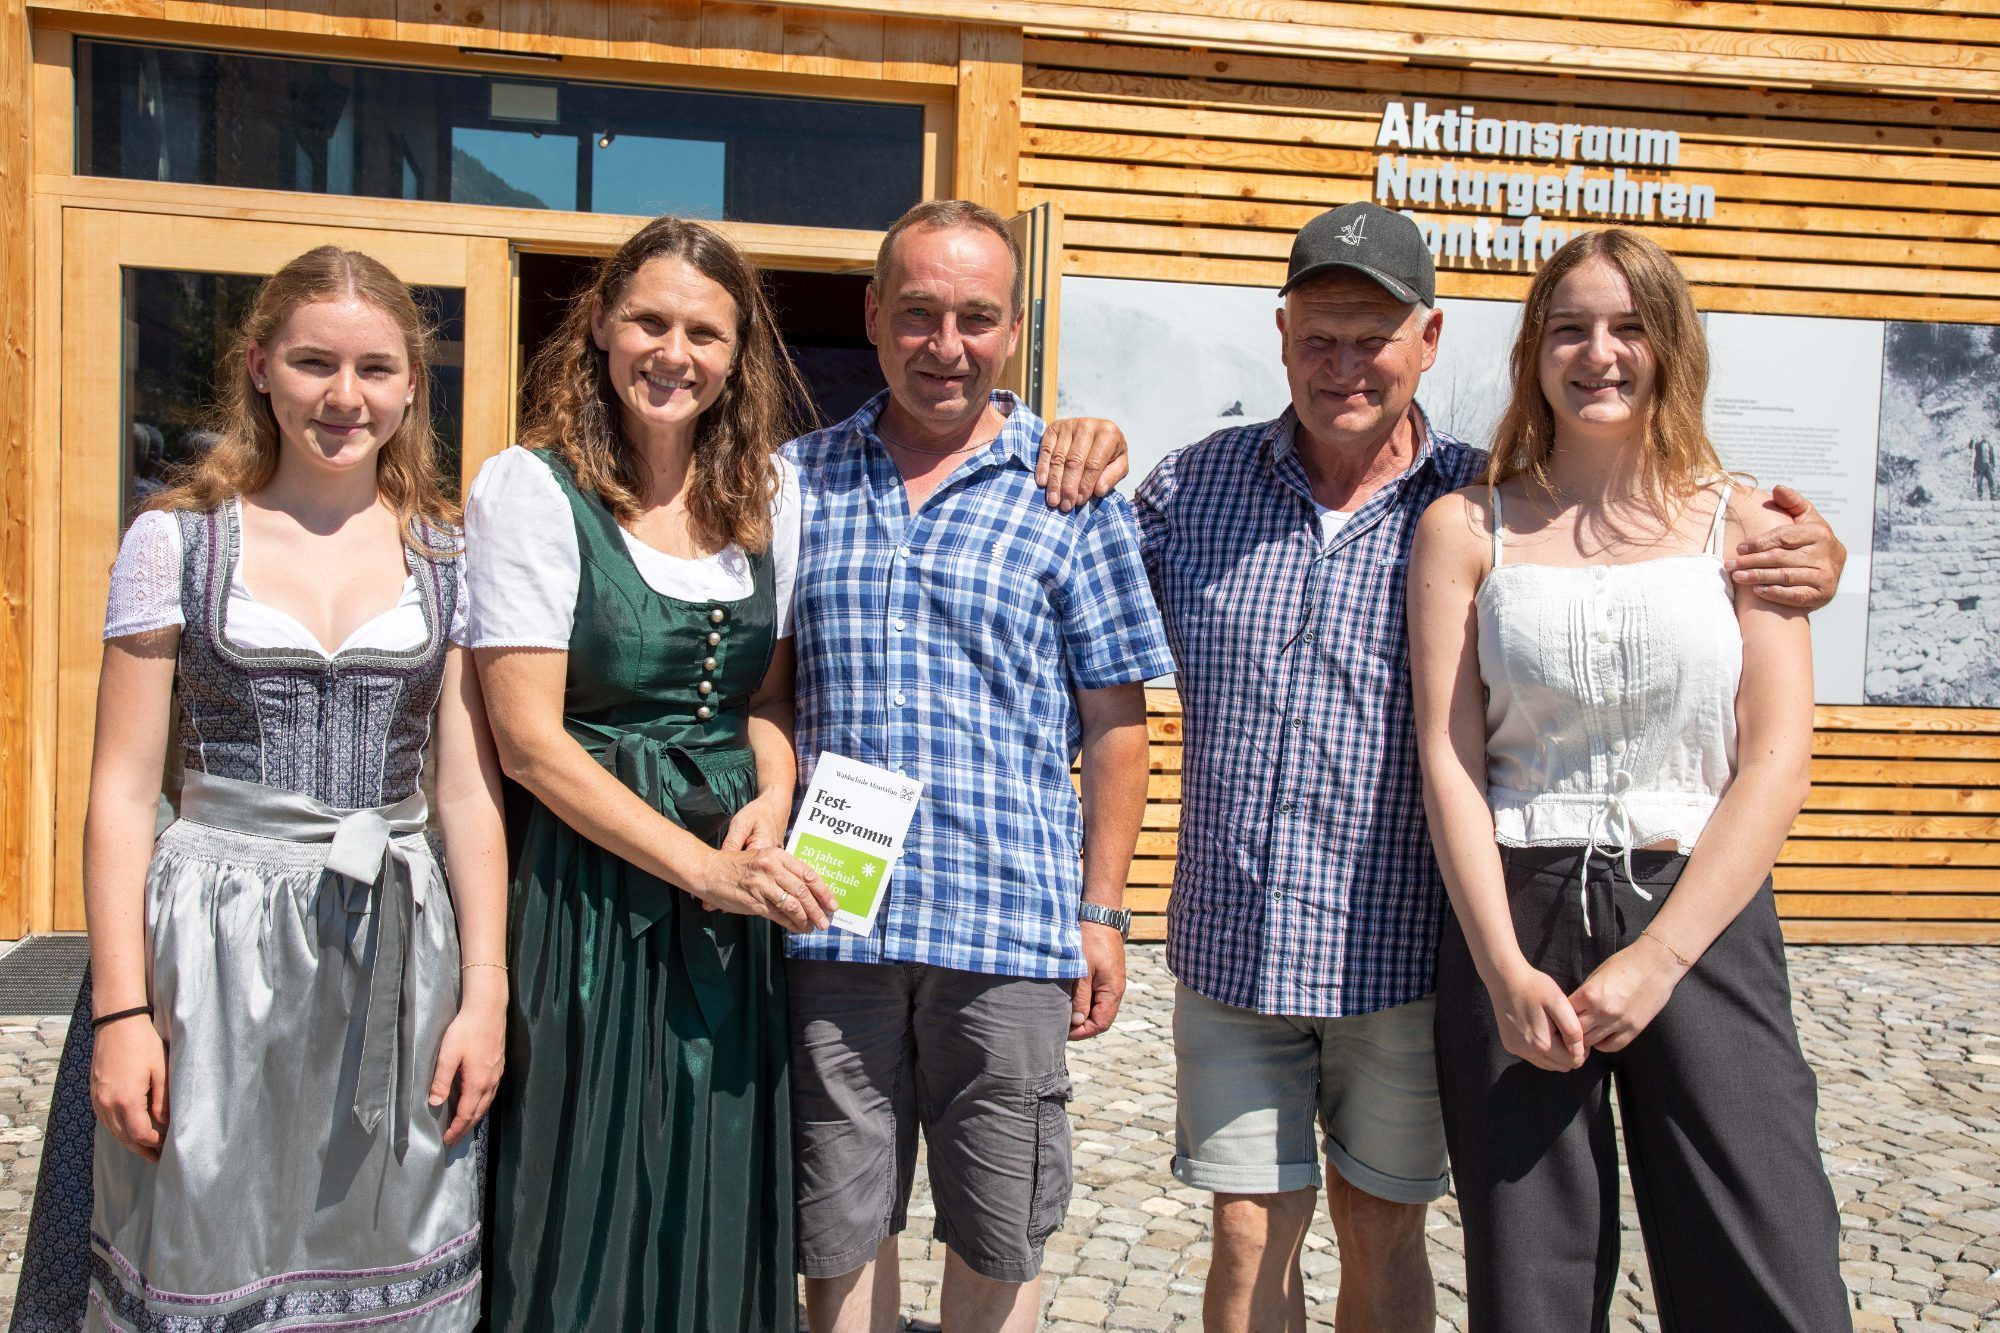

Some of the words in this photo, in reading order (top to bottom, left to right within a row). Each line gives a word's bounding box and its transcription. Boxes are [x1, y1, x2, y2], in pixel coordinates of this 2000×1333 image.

[1376, 101, 1680, 165] Aktionsraum
[1376, 156, 1716, 218] Naturgefahren
[1398, 209, 1586, 262] ontafo
[814, 788, 851, 810] Fest-
[869, 781, 898, 796] Montafon
[808, 807, 893, 847] Programm
[801, 845, 815, 857] 20
[815, 850, 844, 868] Jahre
